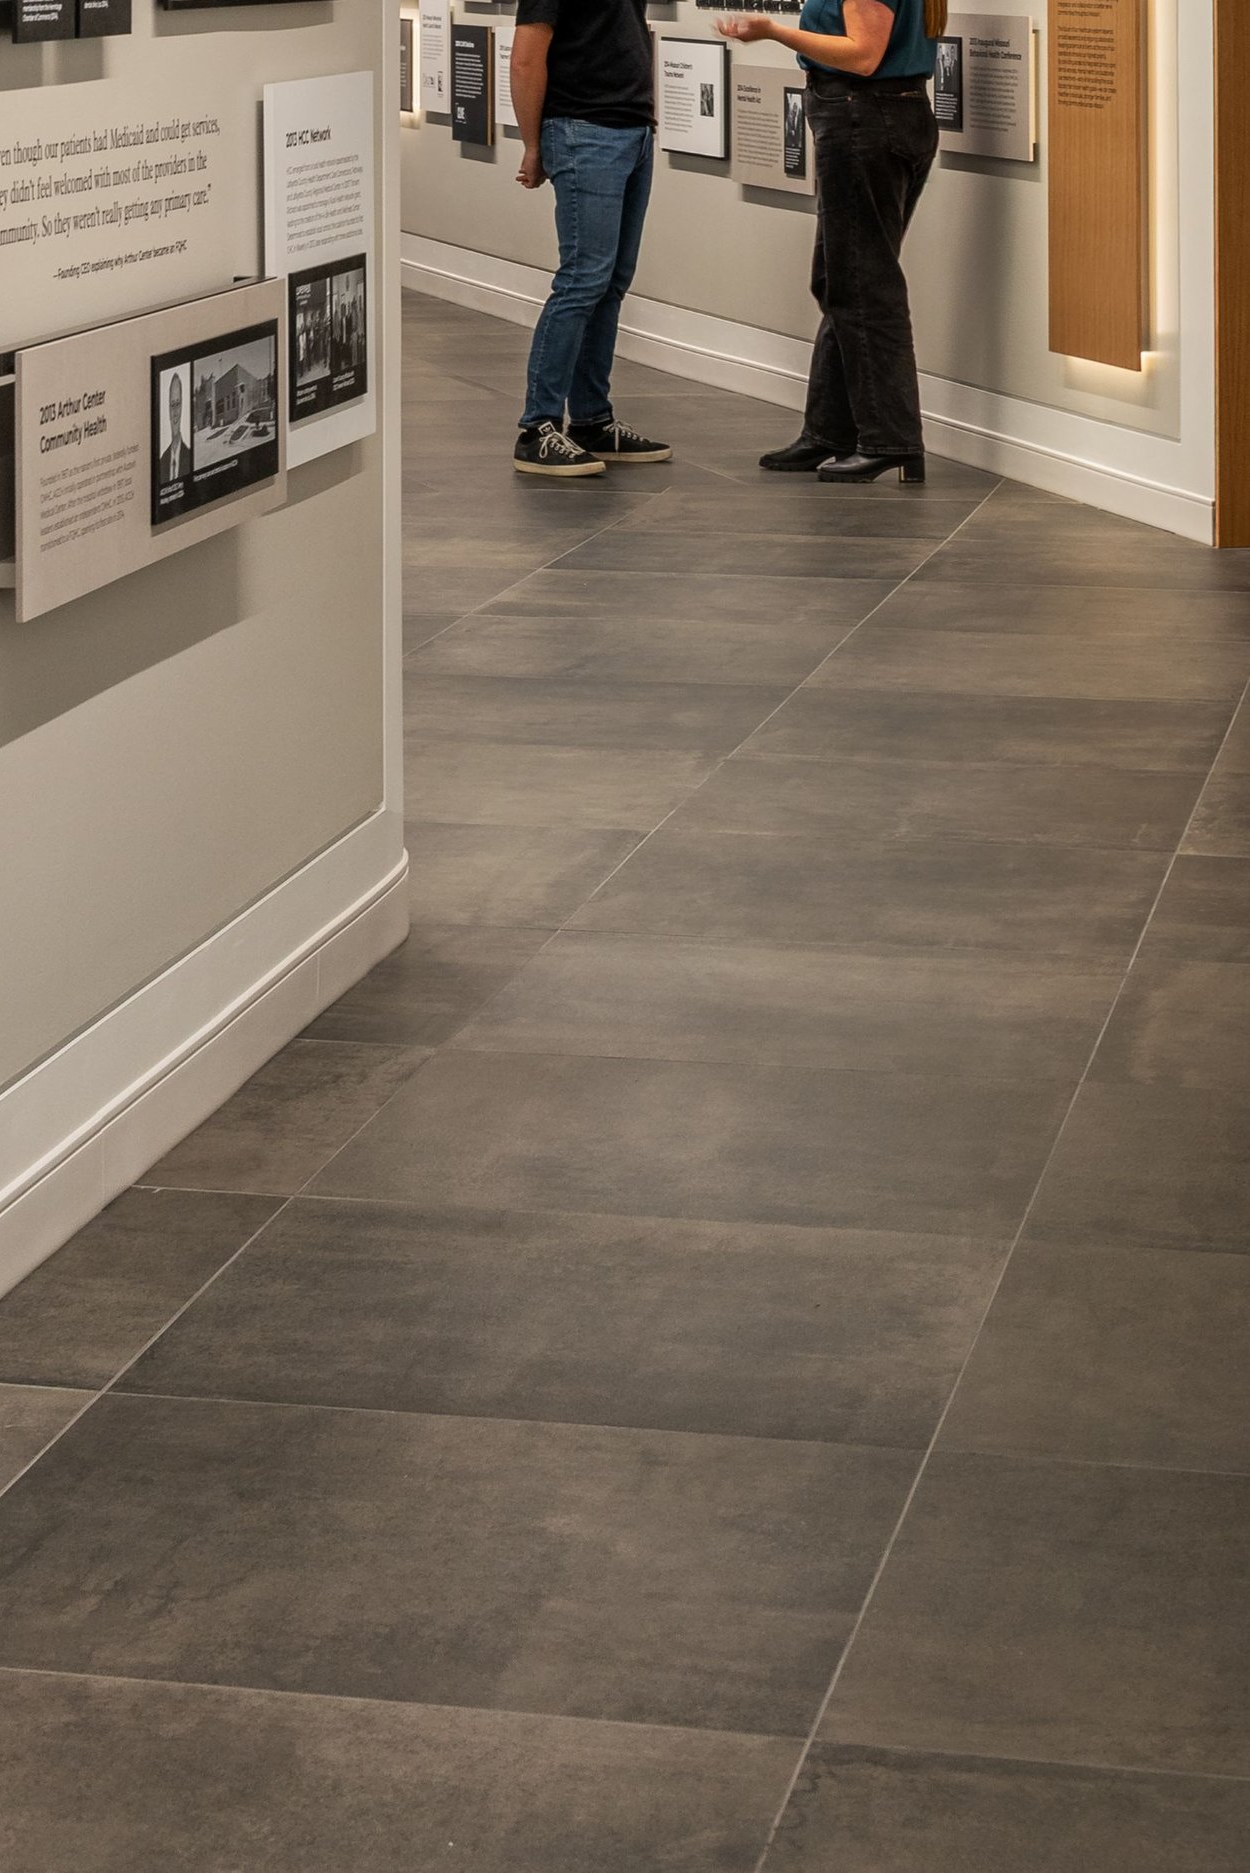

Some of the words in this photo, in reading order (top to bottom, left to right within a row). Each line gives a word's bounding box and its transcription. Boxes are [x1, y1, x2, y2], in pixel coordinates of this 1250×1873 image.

[13, 139, 43, 164] though
[45, 143, 61, 159] our
[61, 131, 94, 160] patients
[93, 129, 111, 152] had
[110, 124, 144, 150] Medicaid
[146, 122, 162, 144] and
[161, 119, 182, 142] could
[181, 122, 193, 143] get
[190, 115, 220, 136] services,
[37, 175, 55, 199] feel
[54, 169, 95, 195] welcomed
[94, 166, 111, 188] with
[113, 167, 133, 186] most
[132, 160, 144, 182] of
[140, 160, 156, 183] the
[155, 153, 189, 182] providers
[188, 152, 198, 172] in
[197, 150, 207, 171] the
[42, 215, 55, 237] So
[54, 212, 74, 236] they
[102, 201, 125, 226] really
[124, 197, 151, 225] getting
[150, 199, 165, 218] any
[165, 191, 191, 217] primary
[57, 398, 81, 419] Arthur
[83, 391, 105, 410] Center
[40, 423, 85, 453] Community
[84, 417, 106, 438] Health
